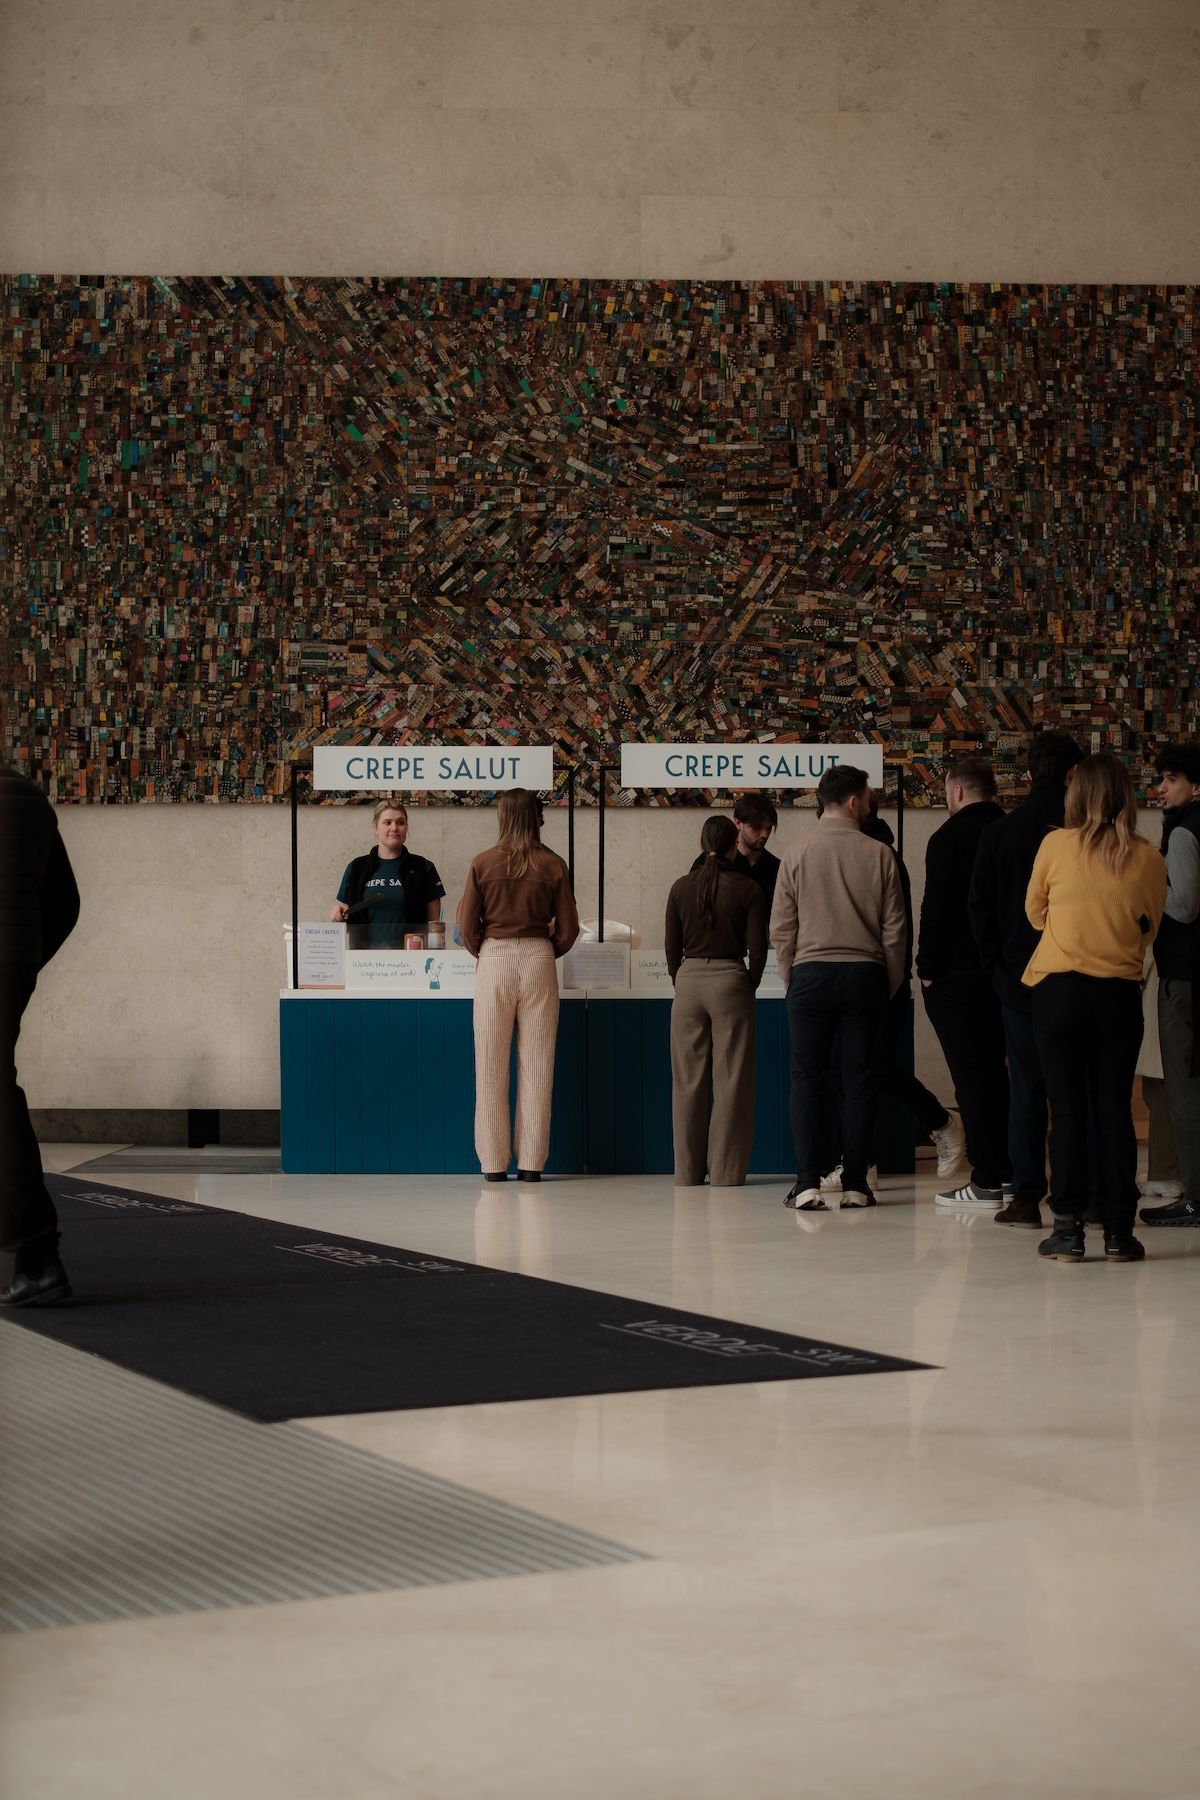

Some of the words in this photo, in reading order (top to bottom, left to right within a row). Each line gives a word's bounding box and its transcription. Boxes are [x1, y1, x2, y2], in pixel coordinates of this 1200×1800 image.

[346, 757, 425, 780] CREPE
[438, 757, 521, 780] SALUT
[665, 754, 744, 777] CREPE
[365, 878, 386, 888] REPE
[352, 959, 374, 968] Watch
[386, 960, 411, 968] master
[293, 1243, 399, 1266] VERDE
[623, 1319, 779, 1354] VERDE
